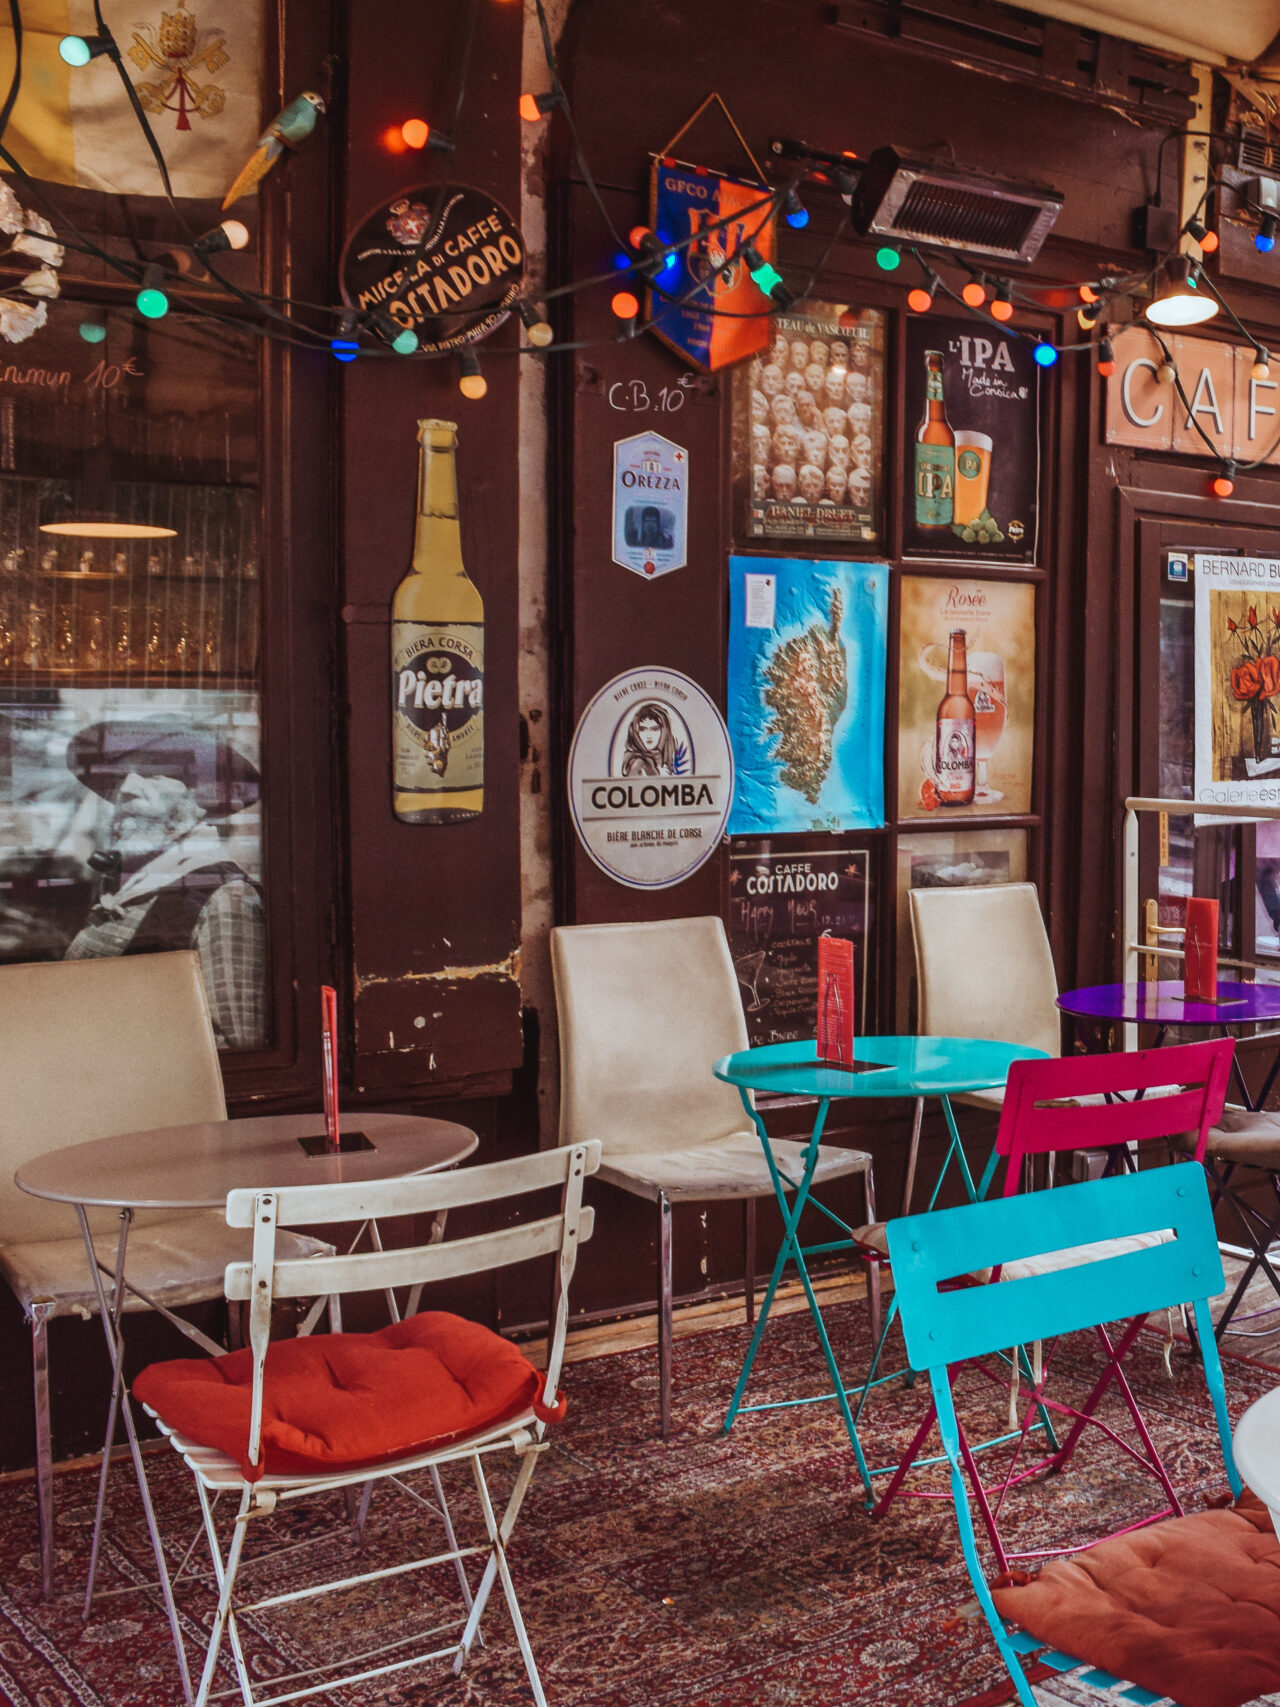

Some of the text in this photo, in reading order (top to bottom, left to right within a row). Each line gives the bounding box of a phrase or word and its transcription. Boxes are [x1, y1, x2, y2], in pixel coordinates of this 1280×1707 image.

[664, 177, 708, 200] GFCO
[432, 253, 445, 267] DI
[376, 235, 522, 335] OSTADORO
[949, 335, 1015, 373] L'IPA
[962, 368, 991, 389] Made
[621, 470, 681, 491] OREZZA
[917, 471, 953, 499] IPA
[1202, 559, 1266, 577] BERNARD
[405, 636, 474, 659] BIERA CORSA
[398, 668, 483, 710] Pietra
[591, 784, 714, 809] COLOMBA
[631, 829, 664, 840] BLANCHE
[667, 829, 676, 839] DE
[680, 828, 702, 838] CORSE
[747, 872, 839, 895] COSTADORO
